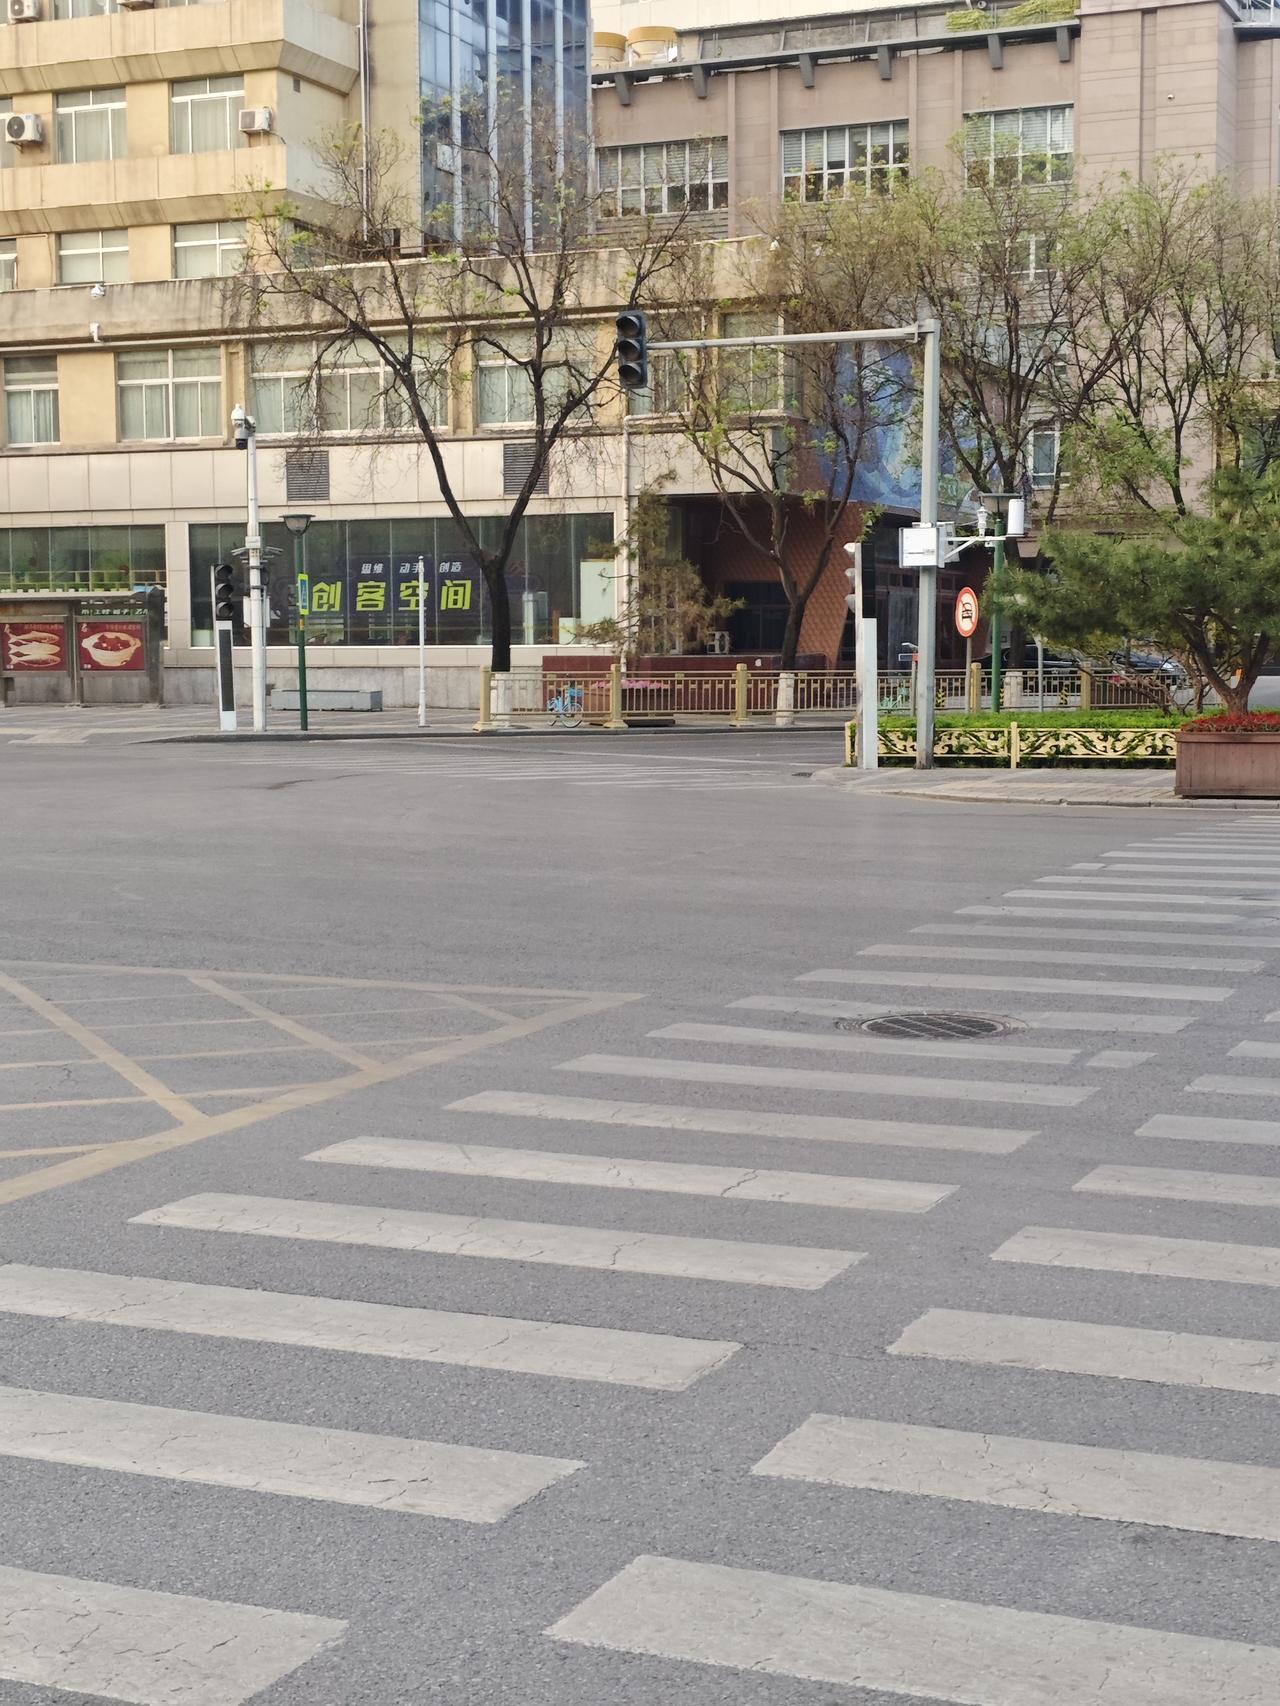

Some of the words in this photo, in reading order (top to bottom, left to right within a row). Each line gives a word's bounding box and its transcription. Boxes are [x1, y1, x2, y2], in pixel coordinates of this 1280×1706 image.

[361, 563, 384, 574] 思维
[440, 561, 462, 573] 创造
[311, 580, 472, 612] 创客空间
